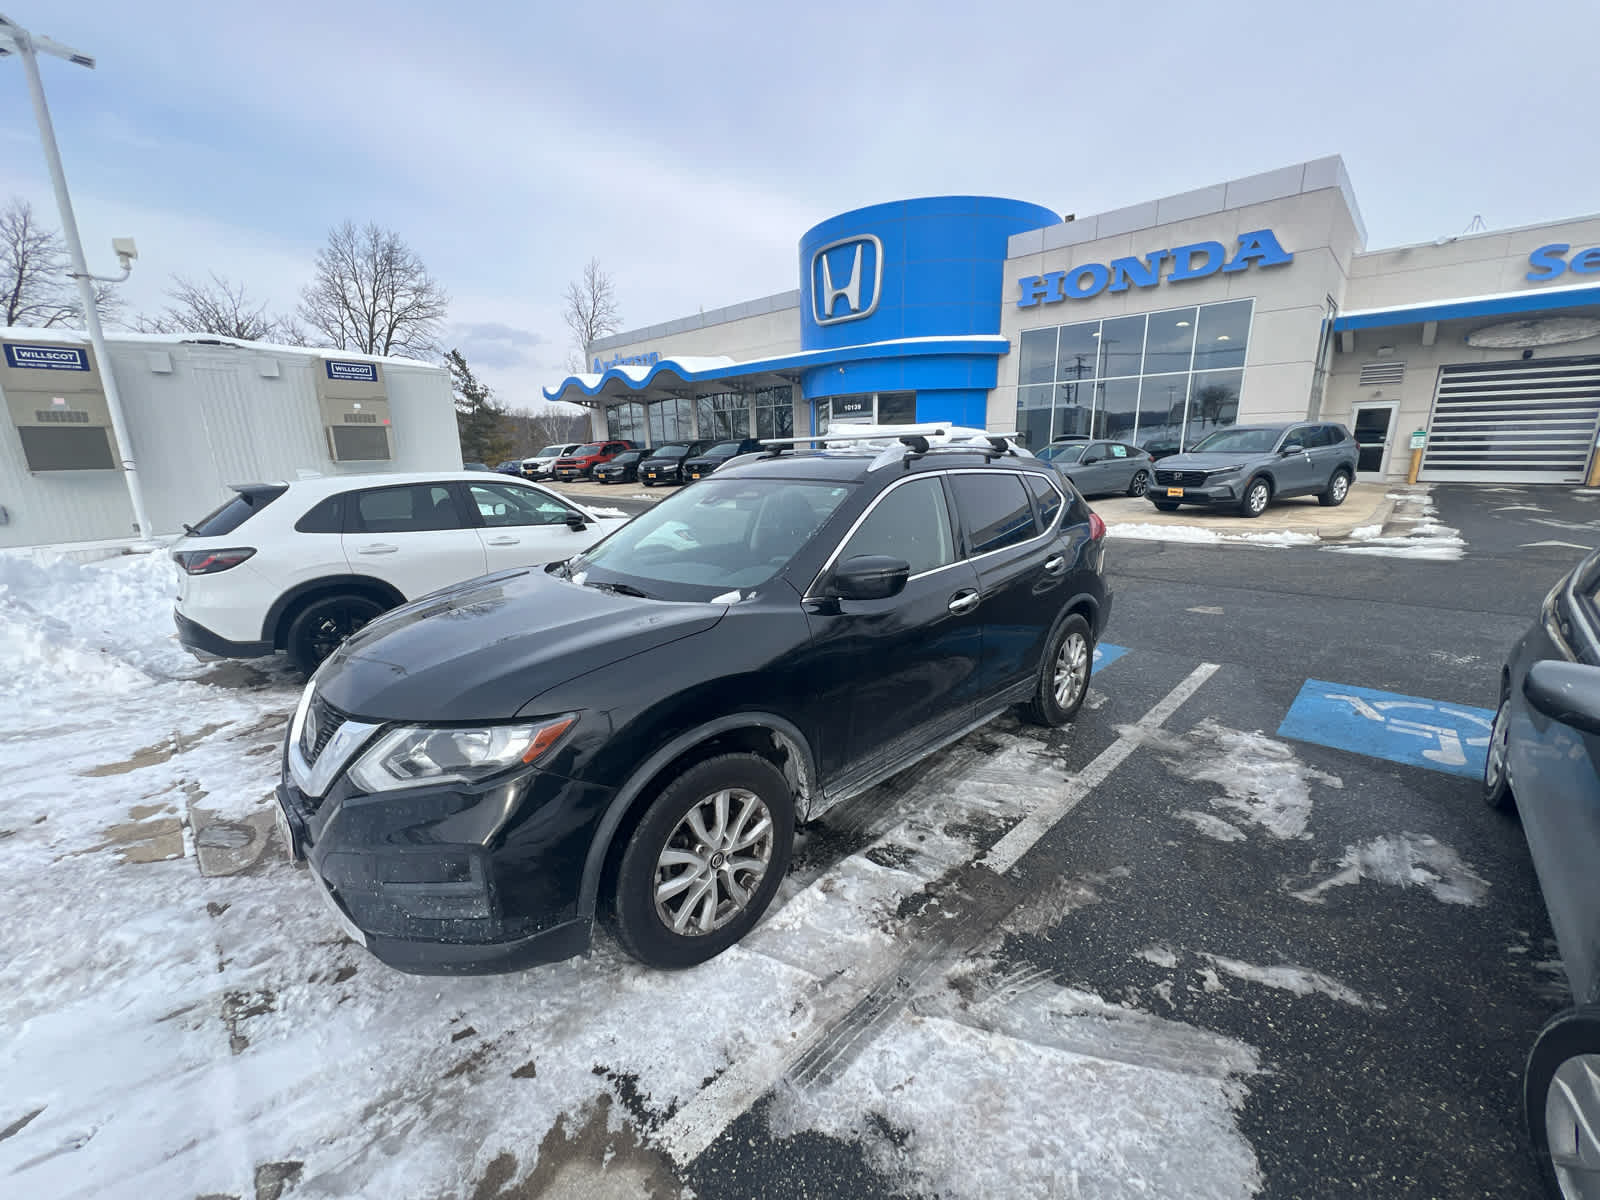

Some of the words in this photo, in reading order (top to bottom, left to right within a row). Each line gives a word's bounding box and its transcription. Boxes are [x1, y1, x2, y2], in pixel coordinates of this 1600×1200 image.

[1016, 228, 1294, 308] HONDA
[1526, 243, 1600, 281] Se
[19, 350, 75, 361] WILLSCOT
[335, 365, 369, 374] WILLSCOT
